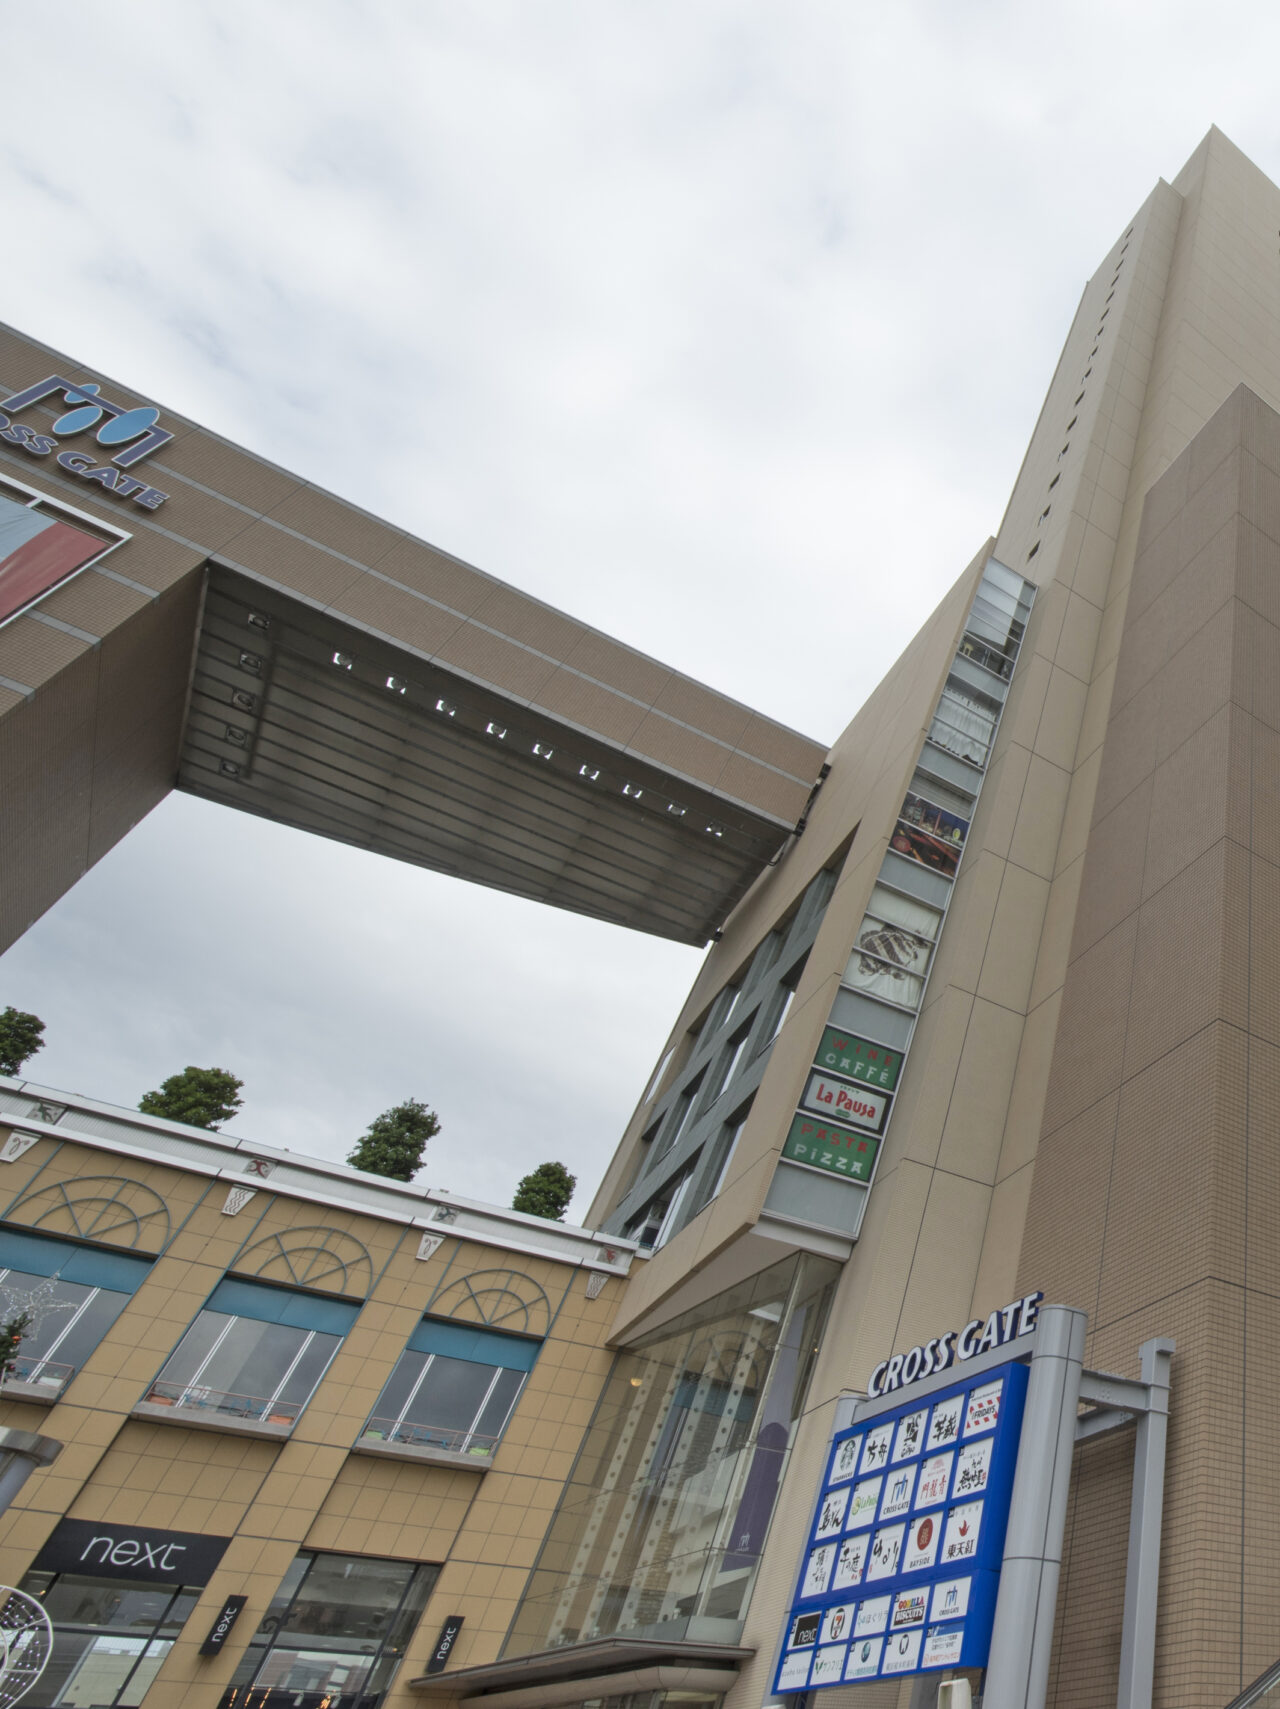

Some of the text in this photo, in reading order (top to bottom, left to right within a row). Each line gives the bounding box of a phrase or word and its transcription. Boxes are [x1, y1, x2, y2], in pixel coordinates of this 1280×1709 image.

[57, 451, 170, 510] GATE
[816, 1083, 877, 1119] La Pausa
[801, 1123, 868, 1154] PASTA
[867, 1291, 1043, 1399] CROSS GATE
[883, 1504, 897, 1515] CROSS
[79, 1536, 187, 1571] next
[909, 1556, 930, 1568] BAYSIDE
[946, 1539, 975, 1559] 東天紅
[211, 1607, 237, 1643] next
[436, 1626, 457, 1660] next
